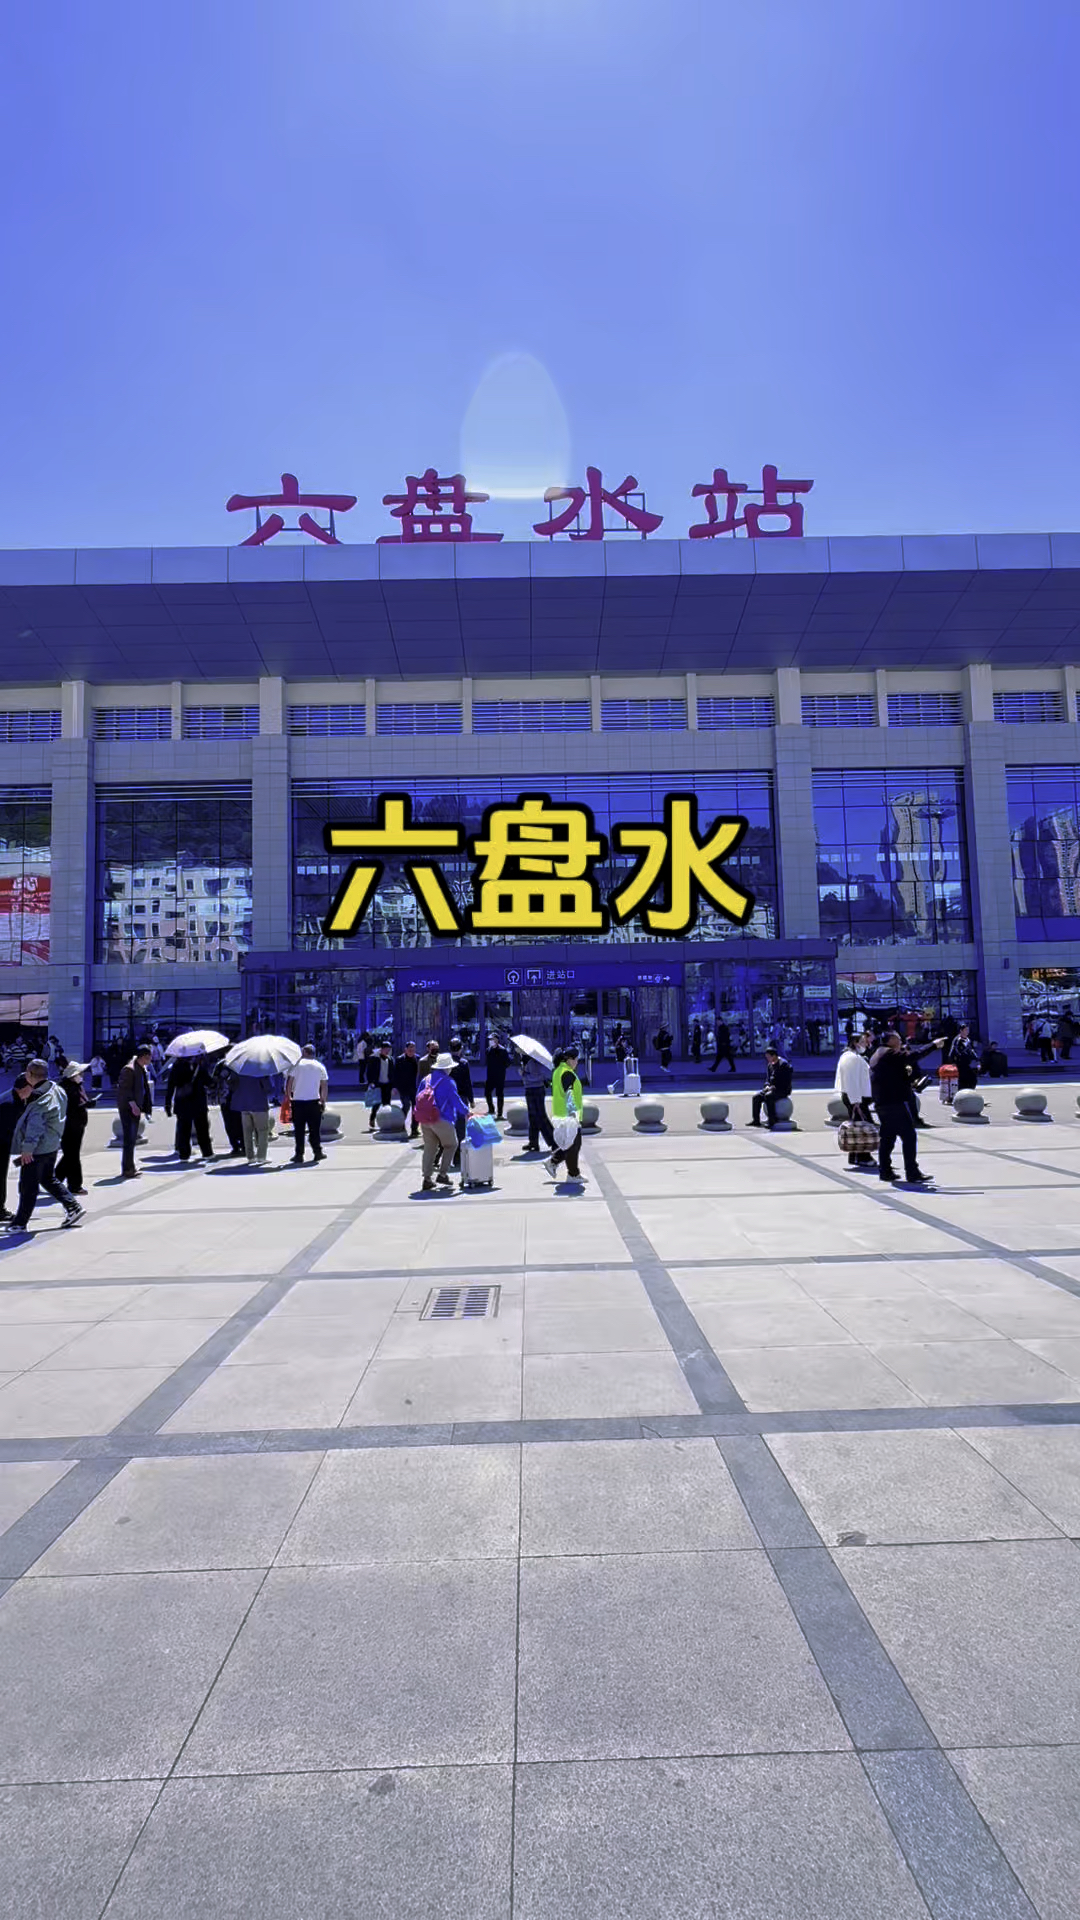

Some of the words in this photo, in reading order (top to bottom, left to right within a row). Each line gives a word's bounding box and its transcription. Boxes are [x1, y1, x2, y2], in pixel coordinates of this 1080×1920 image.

[226, 465, 814, 546] 六盘水站
[546, 969, 575, 980] 进站口
